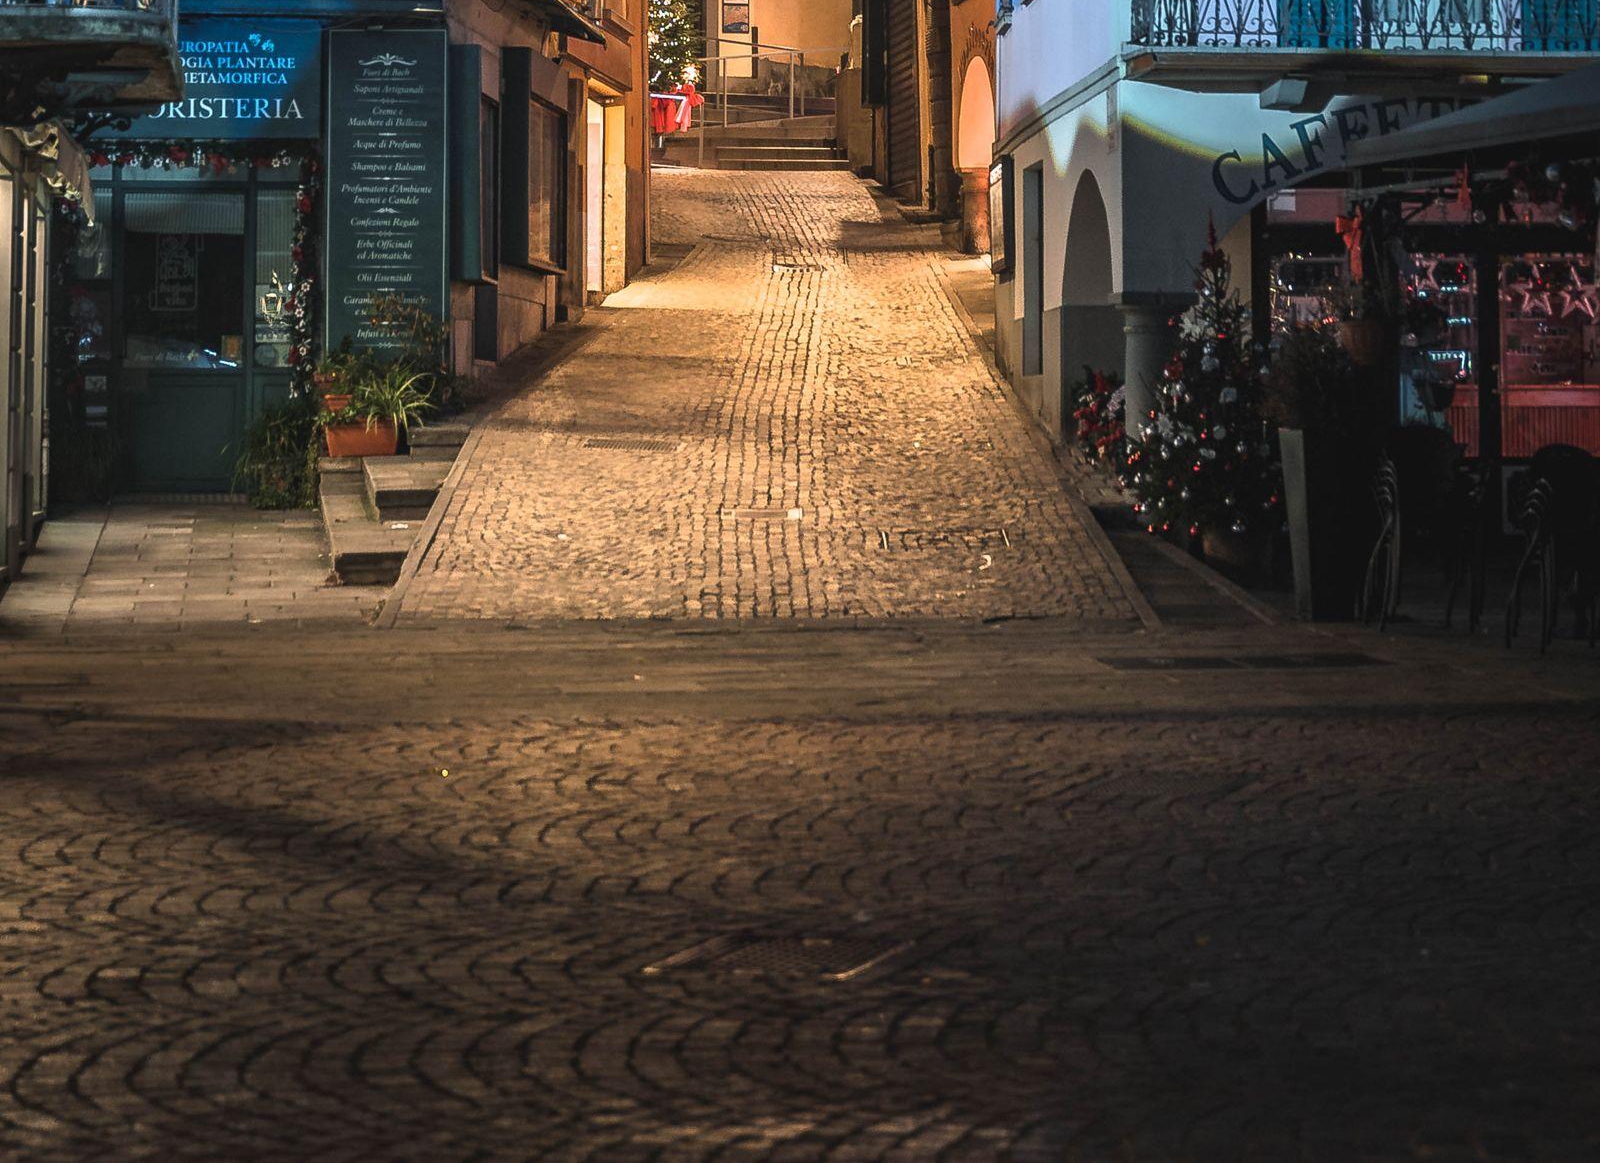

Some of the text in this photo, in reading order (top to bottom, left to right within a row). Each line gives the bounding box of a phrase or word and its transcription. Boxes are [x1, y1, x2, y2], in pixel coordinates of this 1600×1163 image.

[177, 40, 250, 53] UROPATIA
[217, 56, 296, 69] PLANTARE
[392, 68, 410, 77] Bach
[353, 85, 380, 95] Saponi
[372, 106, 398, 115] Creme
[385, 118, 393, 126] di
[395, 118, 428, 127] Bellezza
[353, 139, 421, 150] Acque di Profumo
[351, 162, 387, 172] Shampoo
[394, 162, 426, 171] Balsami
[341, 183, 388, 194] Profumatori
[353, 195, 380, 204] Incensi
[388, 196, 419, 205] Candele
[350, 217, 419, 228] Confezioni Regalo
[356, 239, 413, 250] Erbe Officinali
[356, 250, 412, 260] ed Aromatiche
